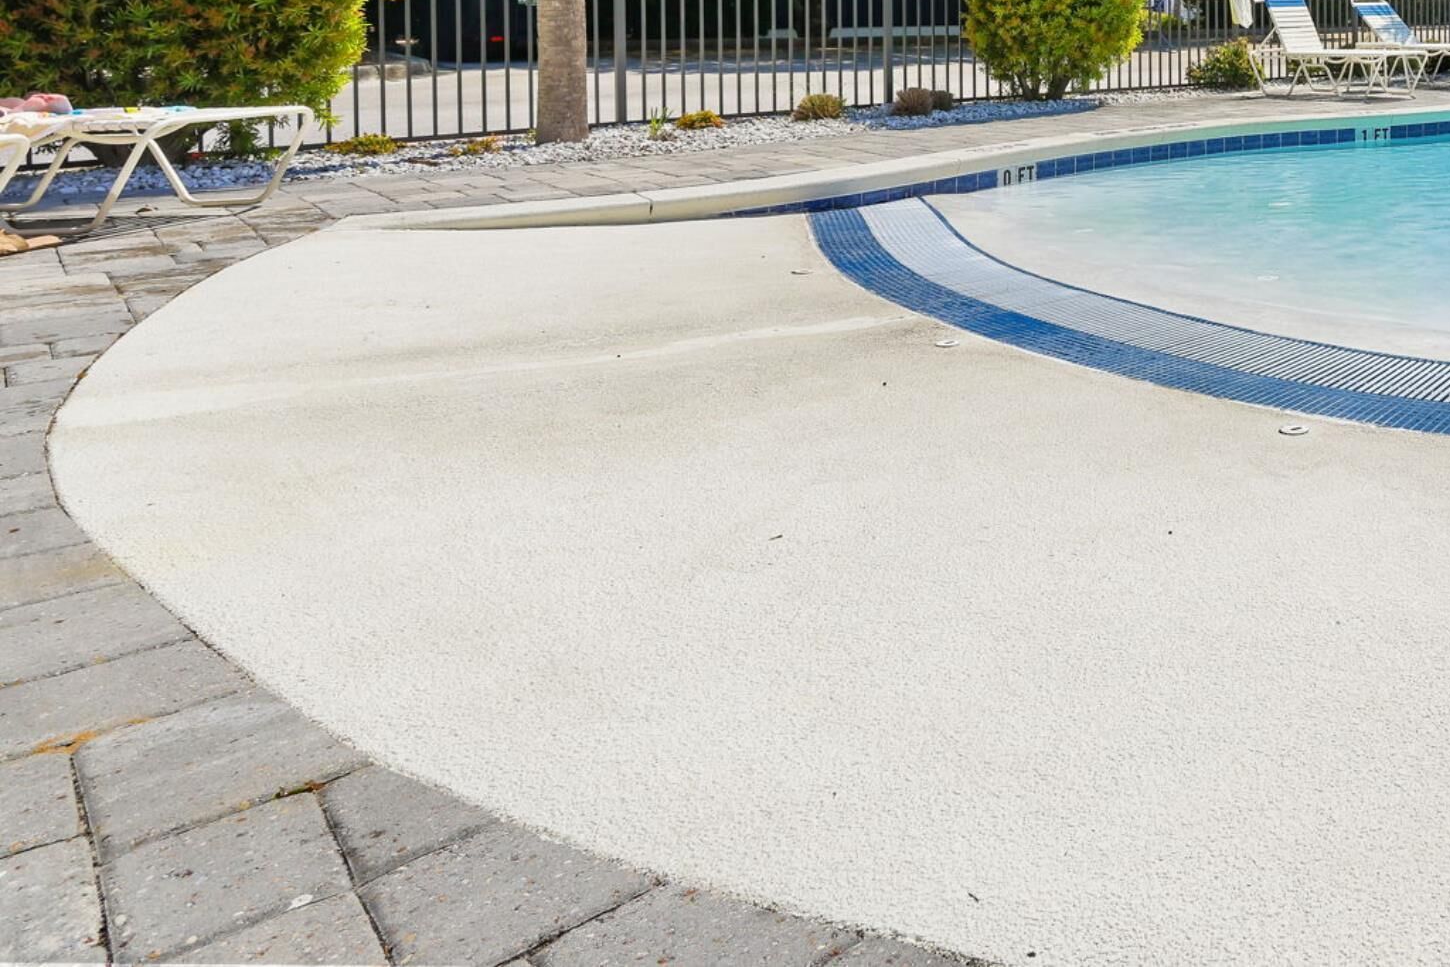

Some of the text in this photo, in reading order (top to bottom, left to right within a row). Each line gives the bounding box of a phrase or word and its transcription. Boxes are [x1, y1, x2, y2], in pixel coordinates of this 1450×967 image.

[1361, 128, 1389, 141] 1 FT
[1003, 165, 1034, 186] 0 FT
